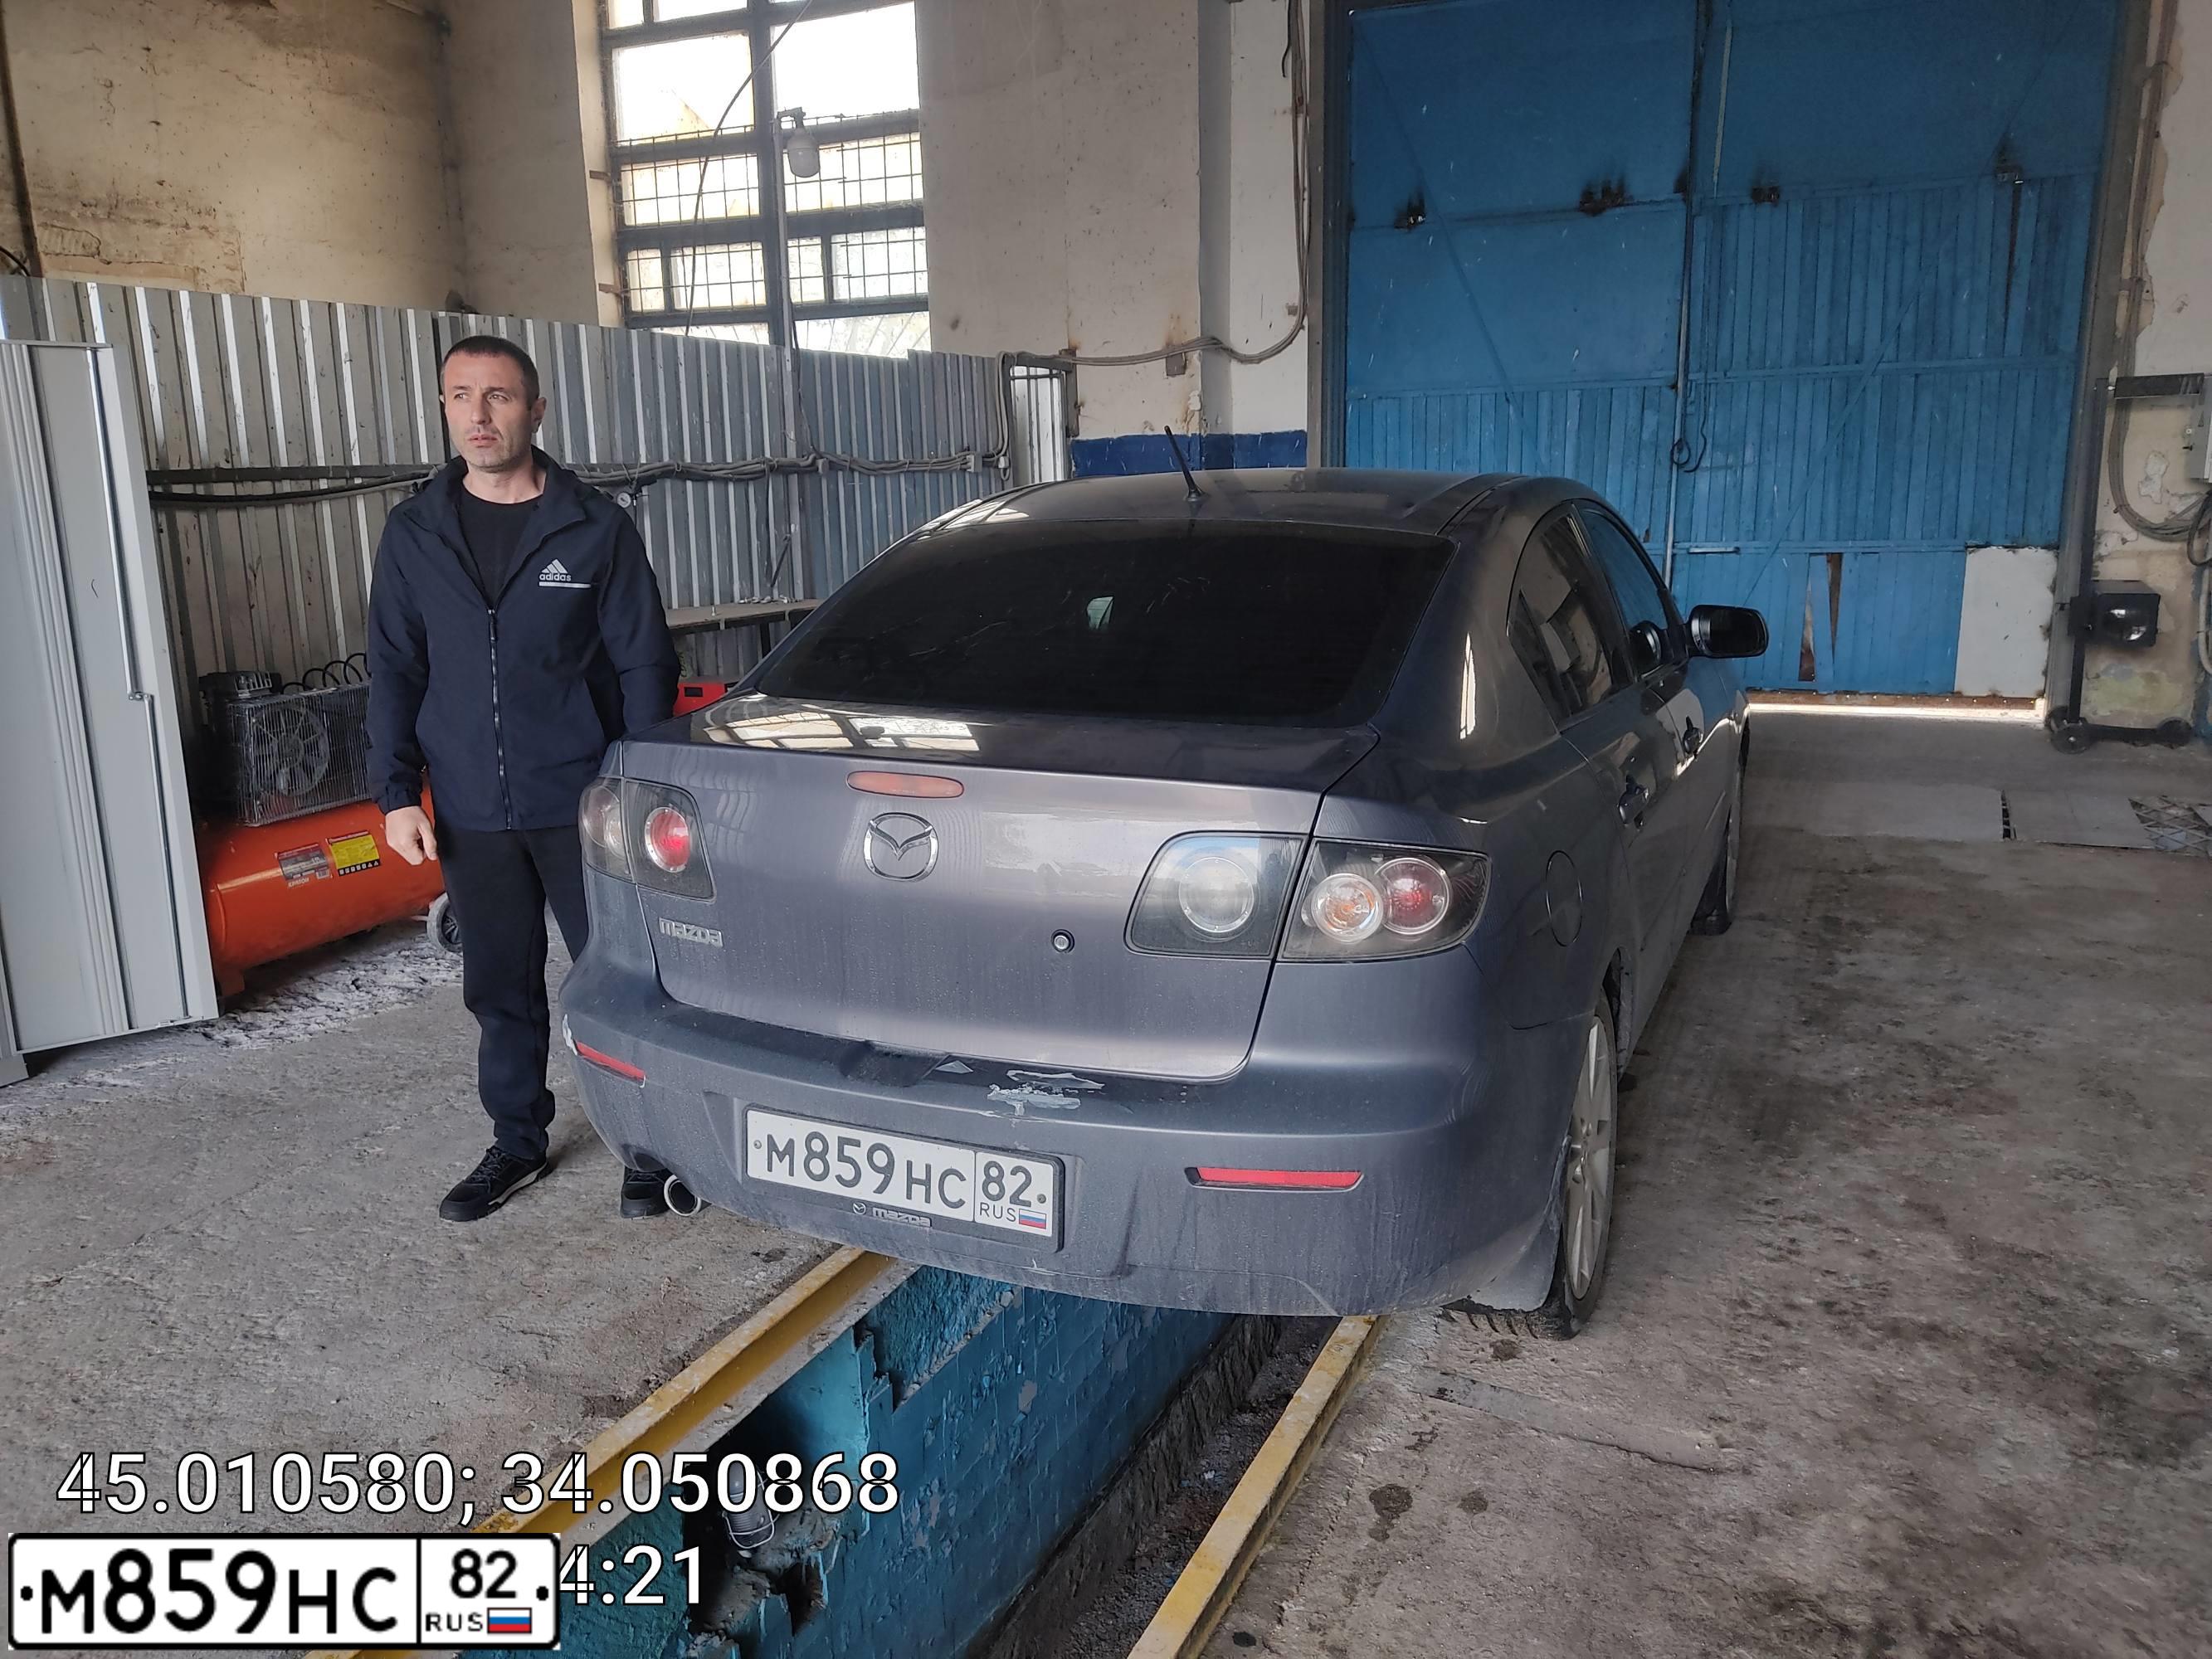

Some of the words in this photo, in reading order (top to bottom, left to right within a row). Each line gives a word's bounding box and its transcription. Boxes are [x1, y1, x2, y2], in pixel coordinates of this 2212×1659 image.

[539, 572, 572, 581] adidas
[766, 1131, 967, 1209] М859НС
[982, 1160, 1032, 1208] 82
[979, 1202, 1016, 1223] RUS
